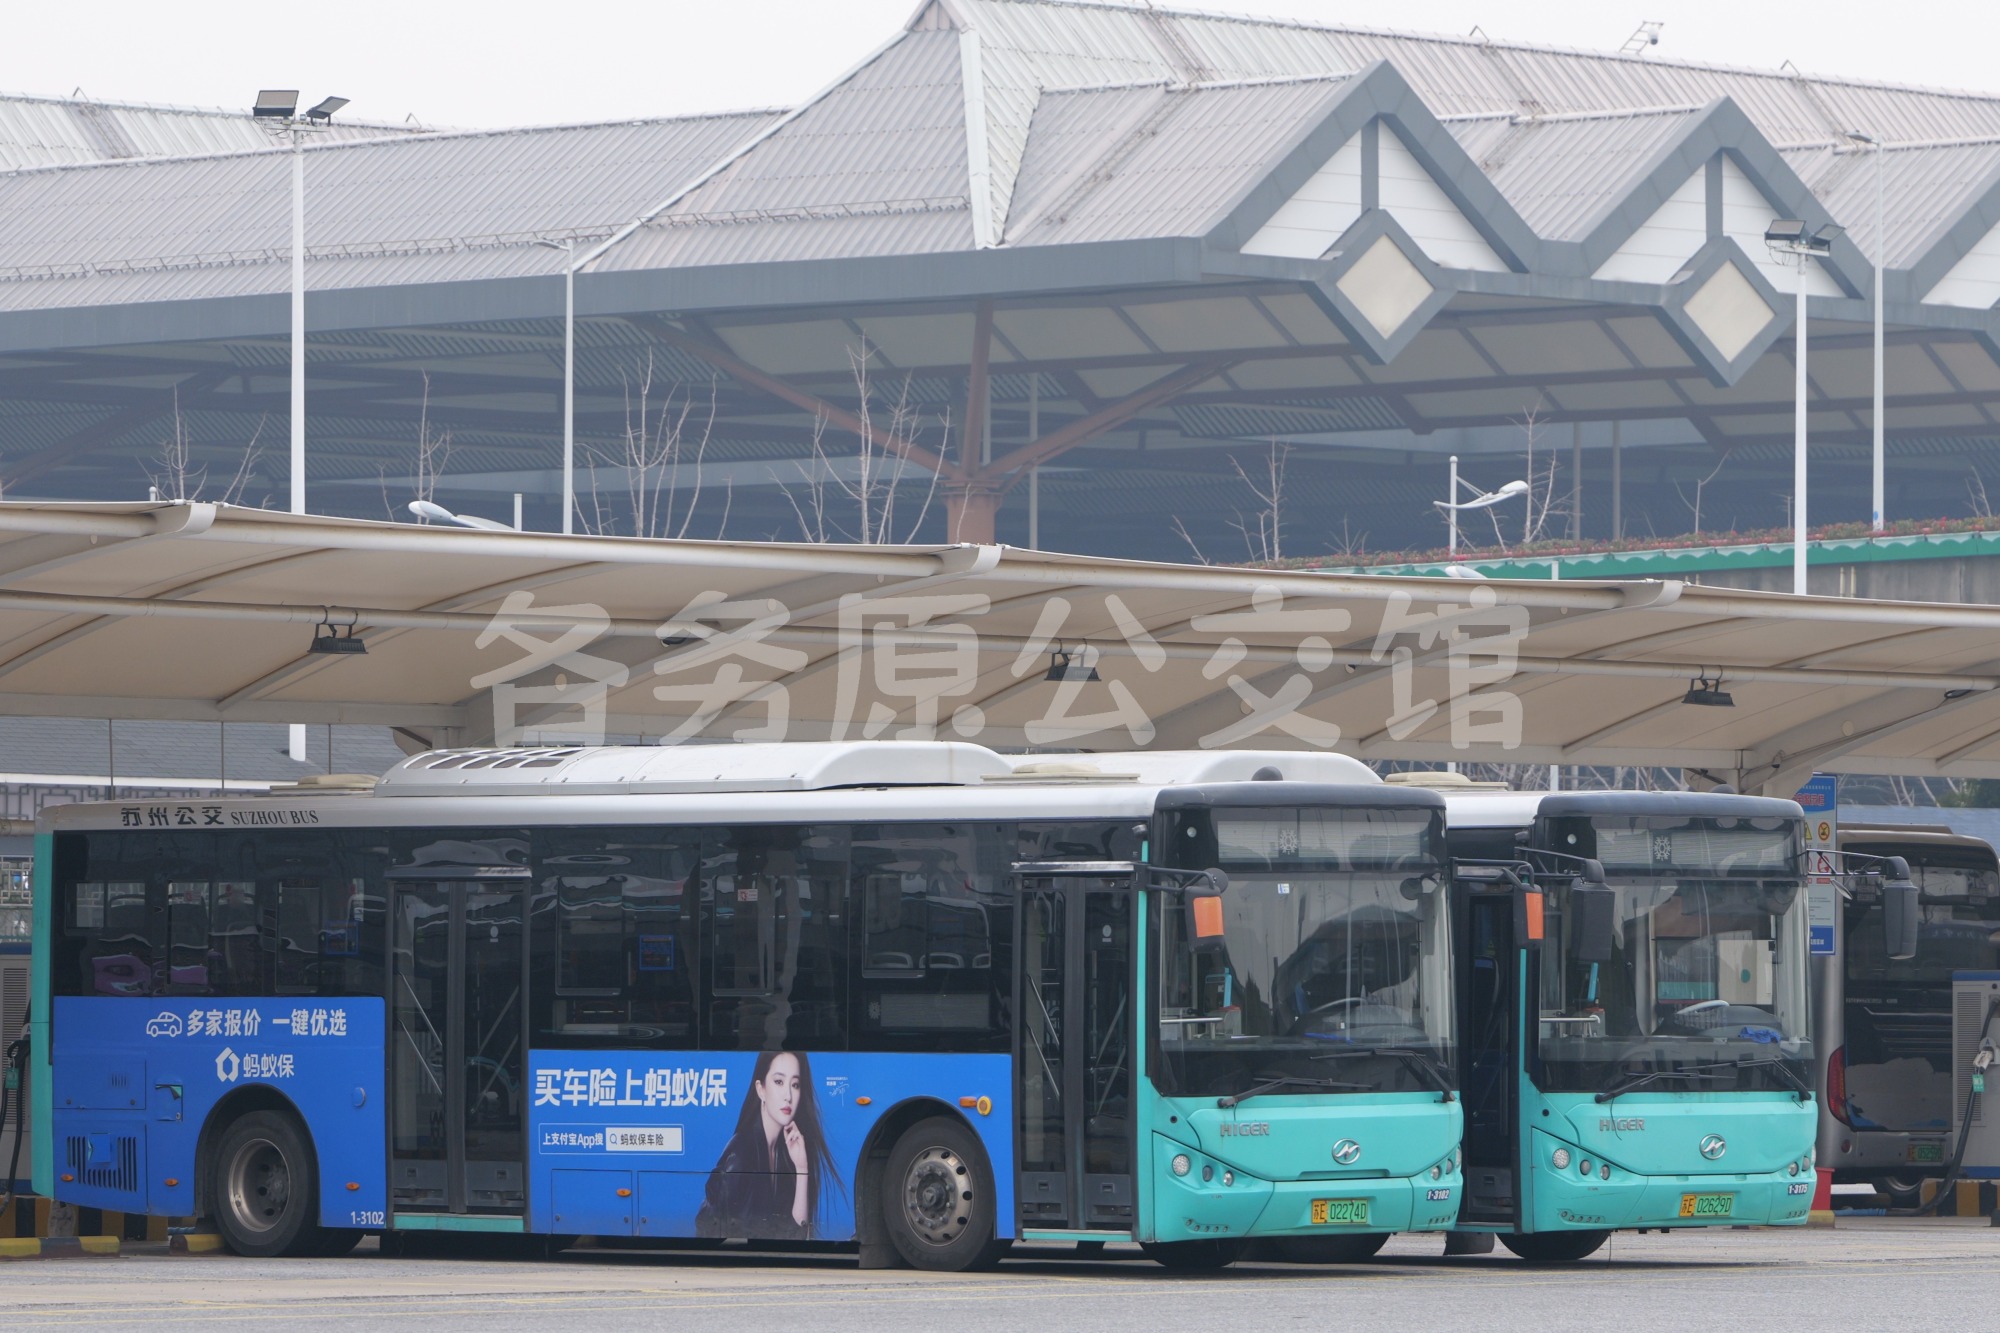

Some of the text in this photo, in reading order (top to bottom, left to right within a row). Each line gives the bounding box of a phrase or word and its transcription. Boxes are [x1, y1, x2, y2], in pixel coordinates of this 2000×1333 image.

[121, 806, 224, 827] 苏州公交
[231, 809, 319, 825] SUZHOU BUS
[187, 1008, 347, 1037] 多家报价 一键优选
[243, 1053, 295, 1078] 蚂蚁保
[534, 1067, 727, 1107] 买车险上蚂蚁保
[1220, 1121, 1270, 1137] HIGER
[1599, 1117, 1646, 1132] HIGER
[542, 1132, 604, 1149] 上支付宝App搜
[620, 1133, 664, 1147] 蚂蚁保车险
[1330, 1203, 1366, 1220] 02274D
[1696, 1197, 1731, 1214] 02629D
[350, 1210, 385, 1225] 1-3102
